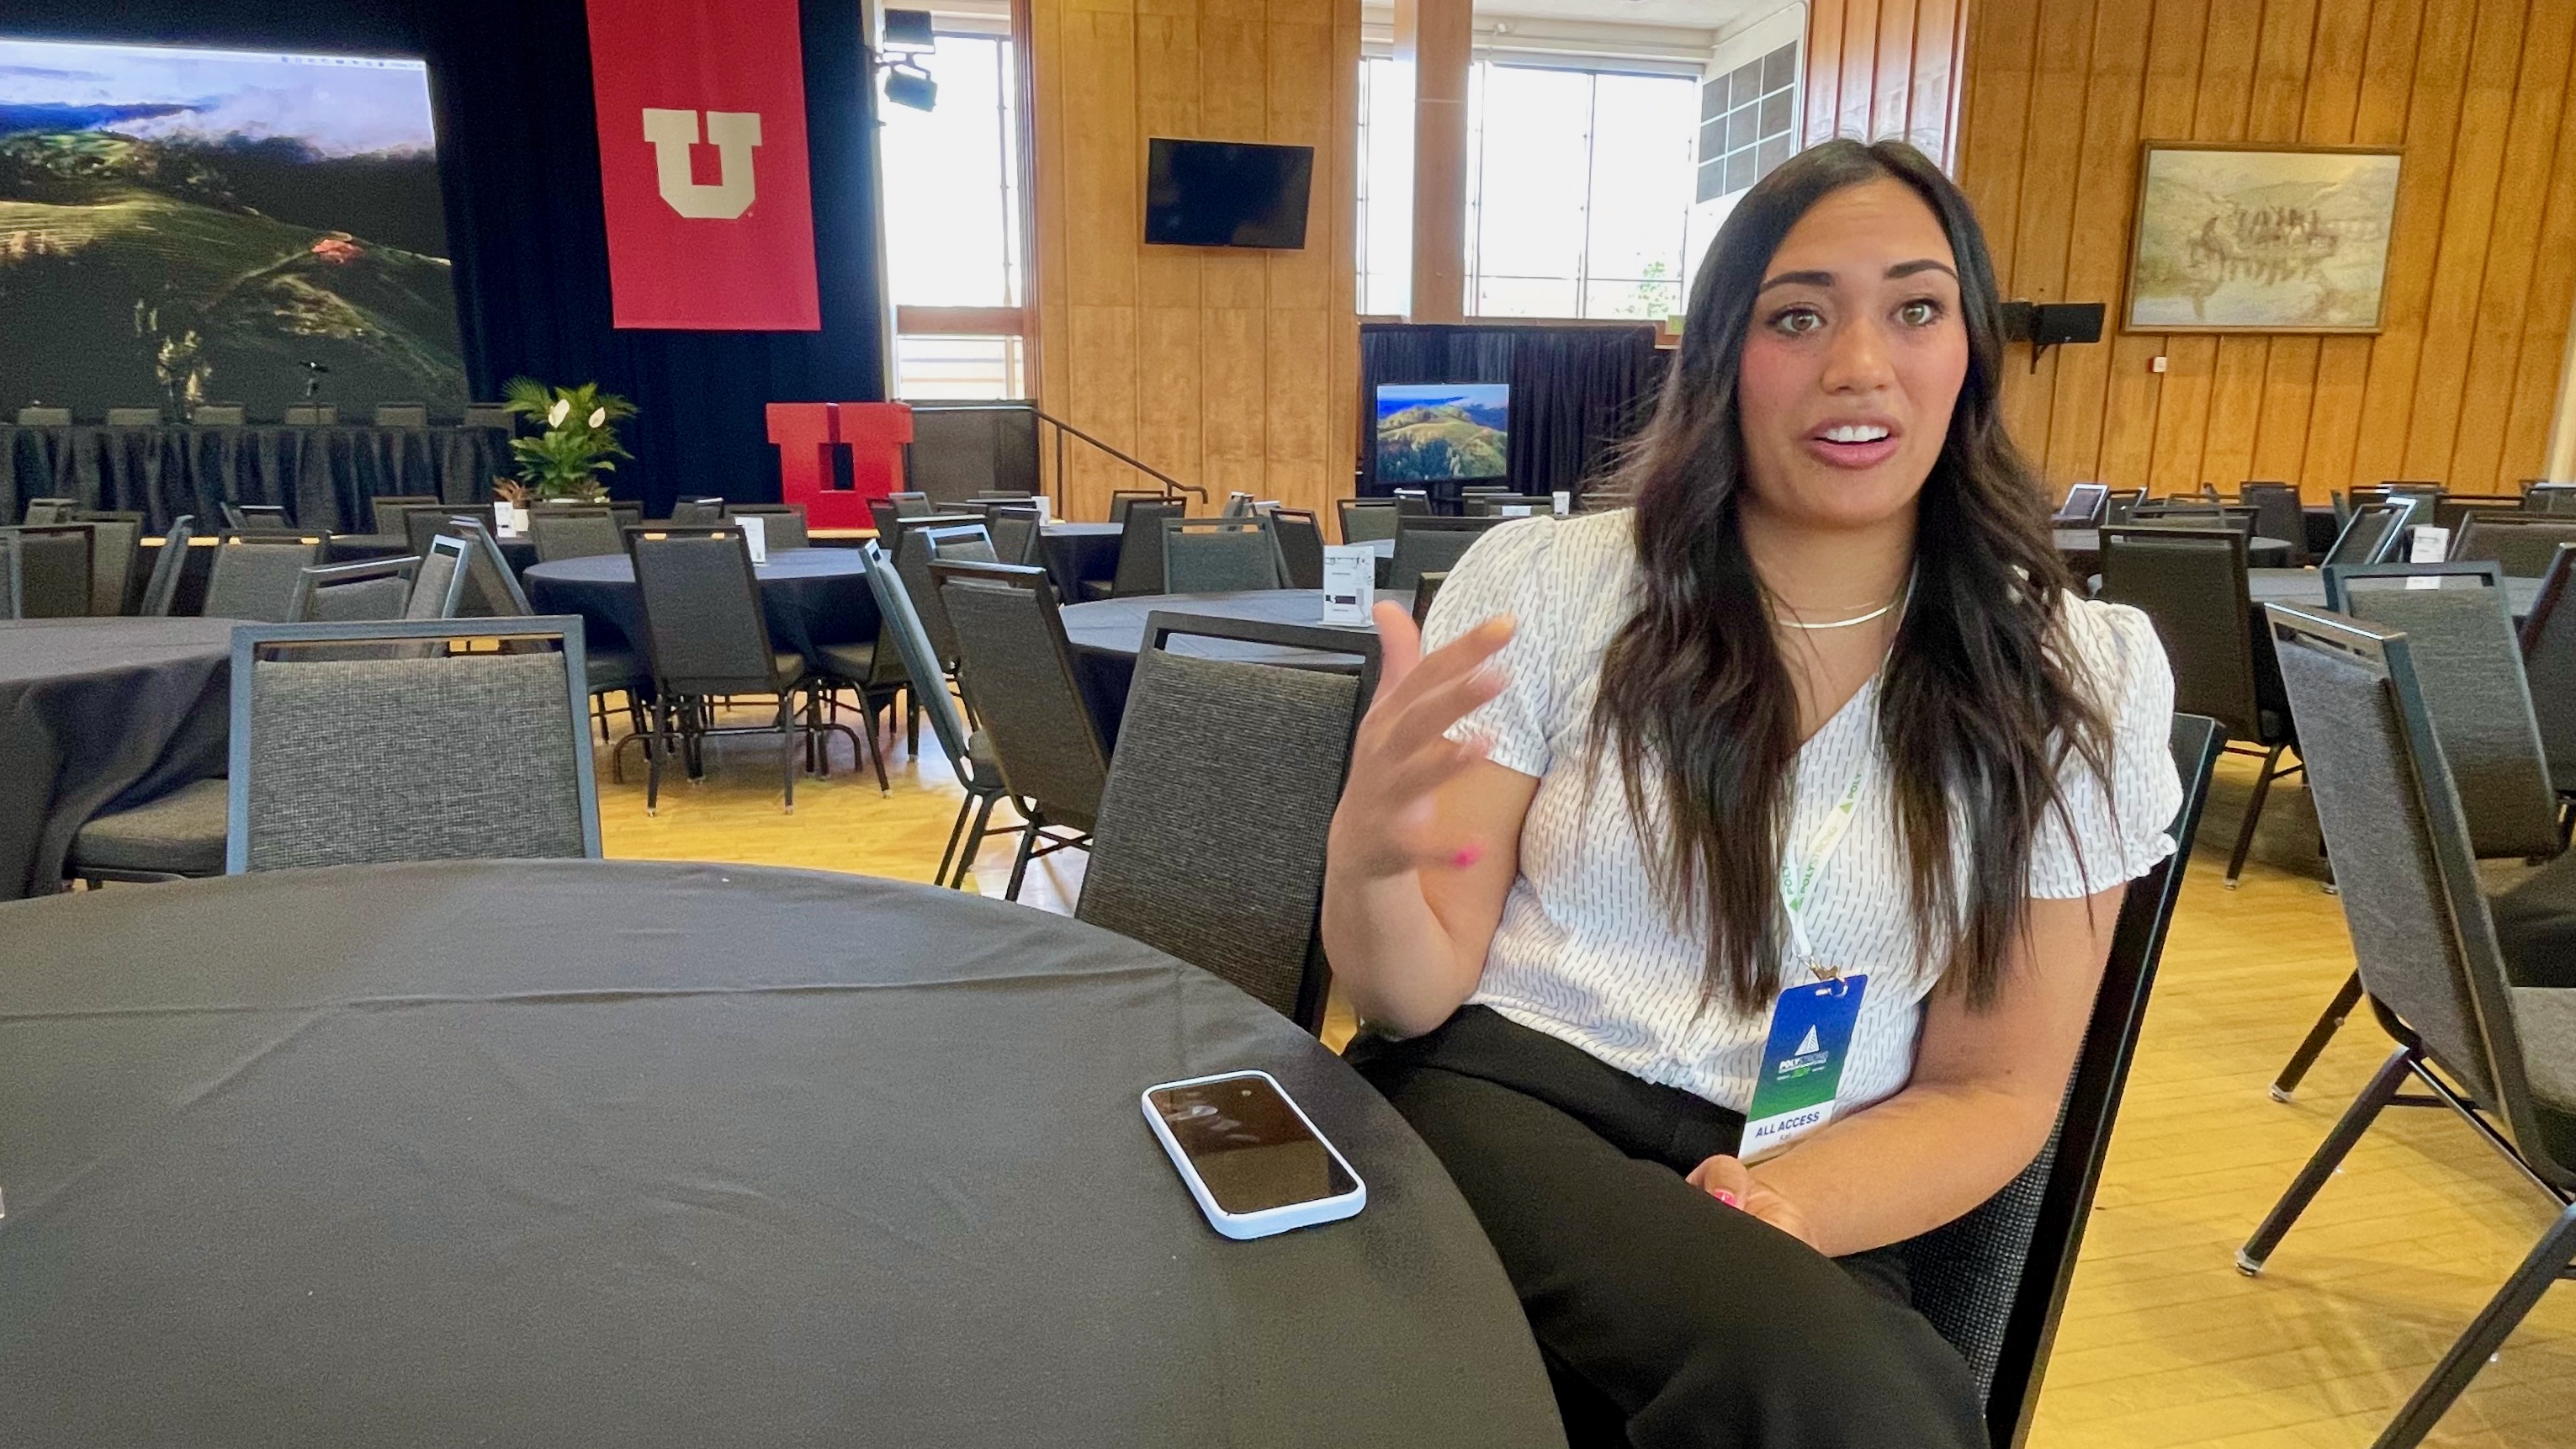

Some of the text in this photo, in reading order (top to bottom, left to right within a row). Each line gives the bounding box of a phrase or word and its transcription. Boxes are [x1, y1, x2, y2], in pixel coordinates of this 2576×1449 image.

[643, 109, 762, 219] U
[766, 402, 913, 528] U
[1800, 826, 1838, 894] POLYSTRONG
[1755, 1123, 1776, 1138] ALL
[1777, 1111, 1821, 1132] ACCESS
